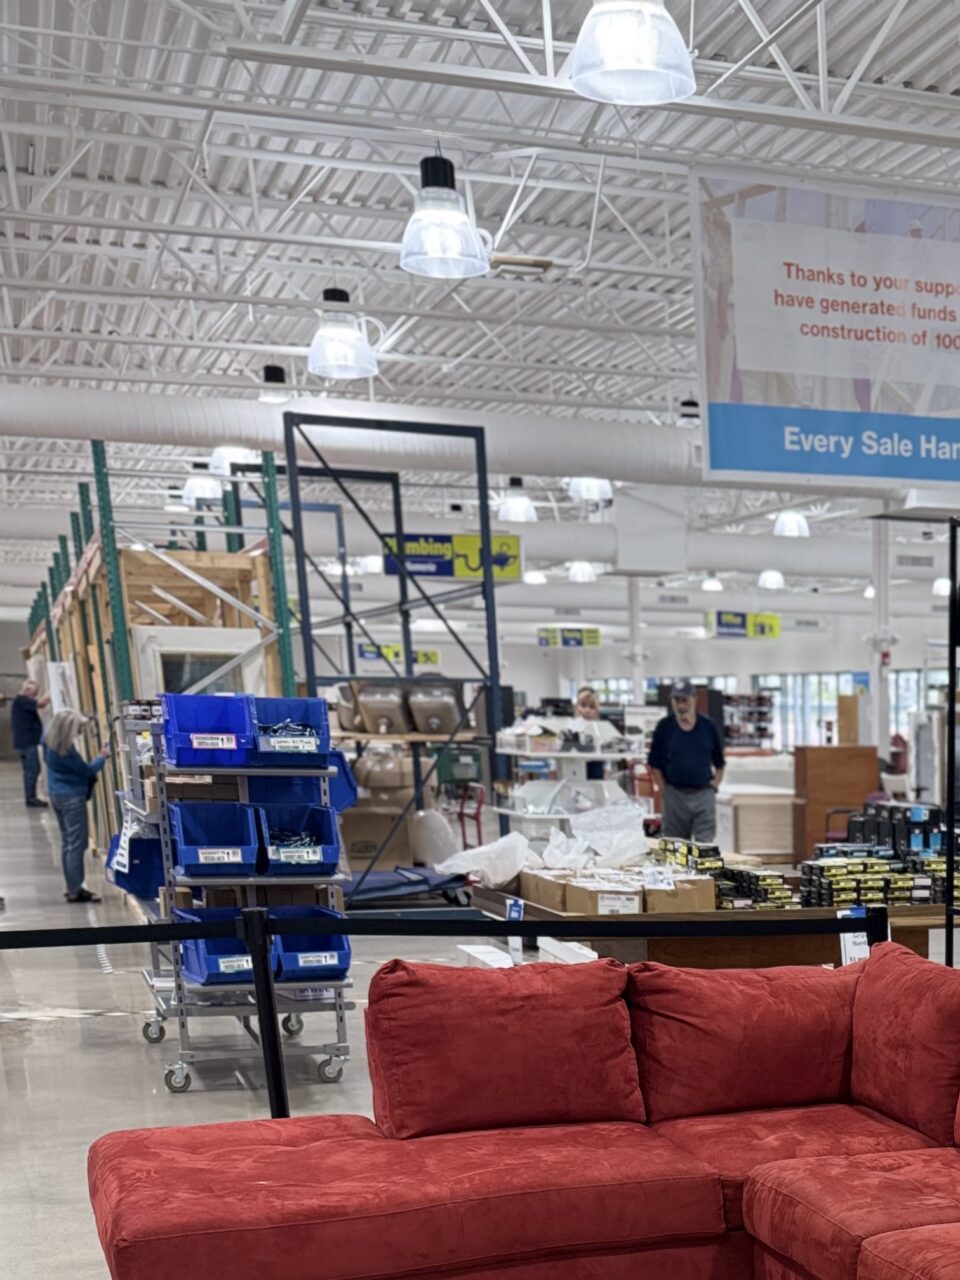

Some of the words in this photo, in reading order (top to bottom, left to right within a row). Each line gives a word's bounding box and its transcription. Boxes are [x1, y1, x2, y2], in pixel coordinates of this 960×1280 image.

[783, 262, 845, 286] Thanks
[850, 271, 867, 288] to
[873, 274, 909, 292] your
[774, 289, 815, 308] have
[820, 297, 907, 316] generated
[912, 303, 957, 322] funds
[800, 323, 907, 344] construction
[912, 330, 928, 346] of
[783, 425, 854, 459] Every
[861, 430, 913, 458] Sale
[384, 537, 452, 560] Plmbing
